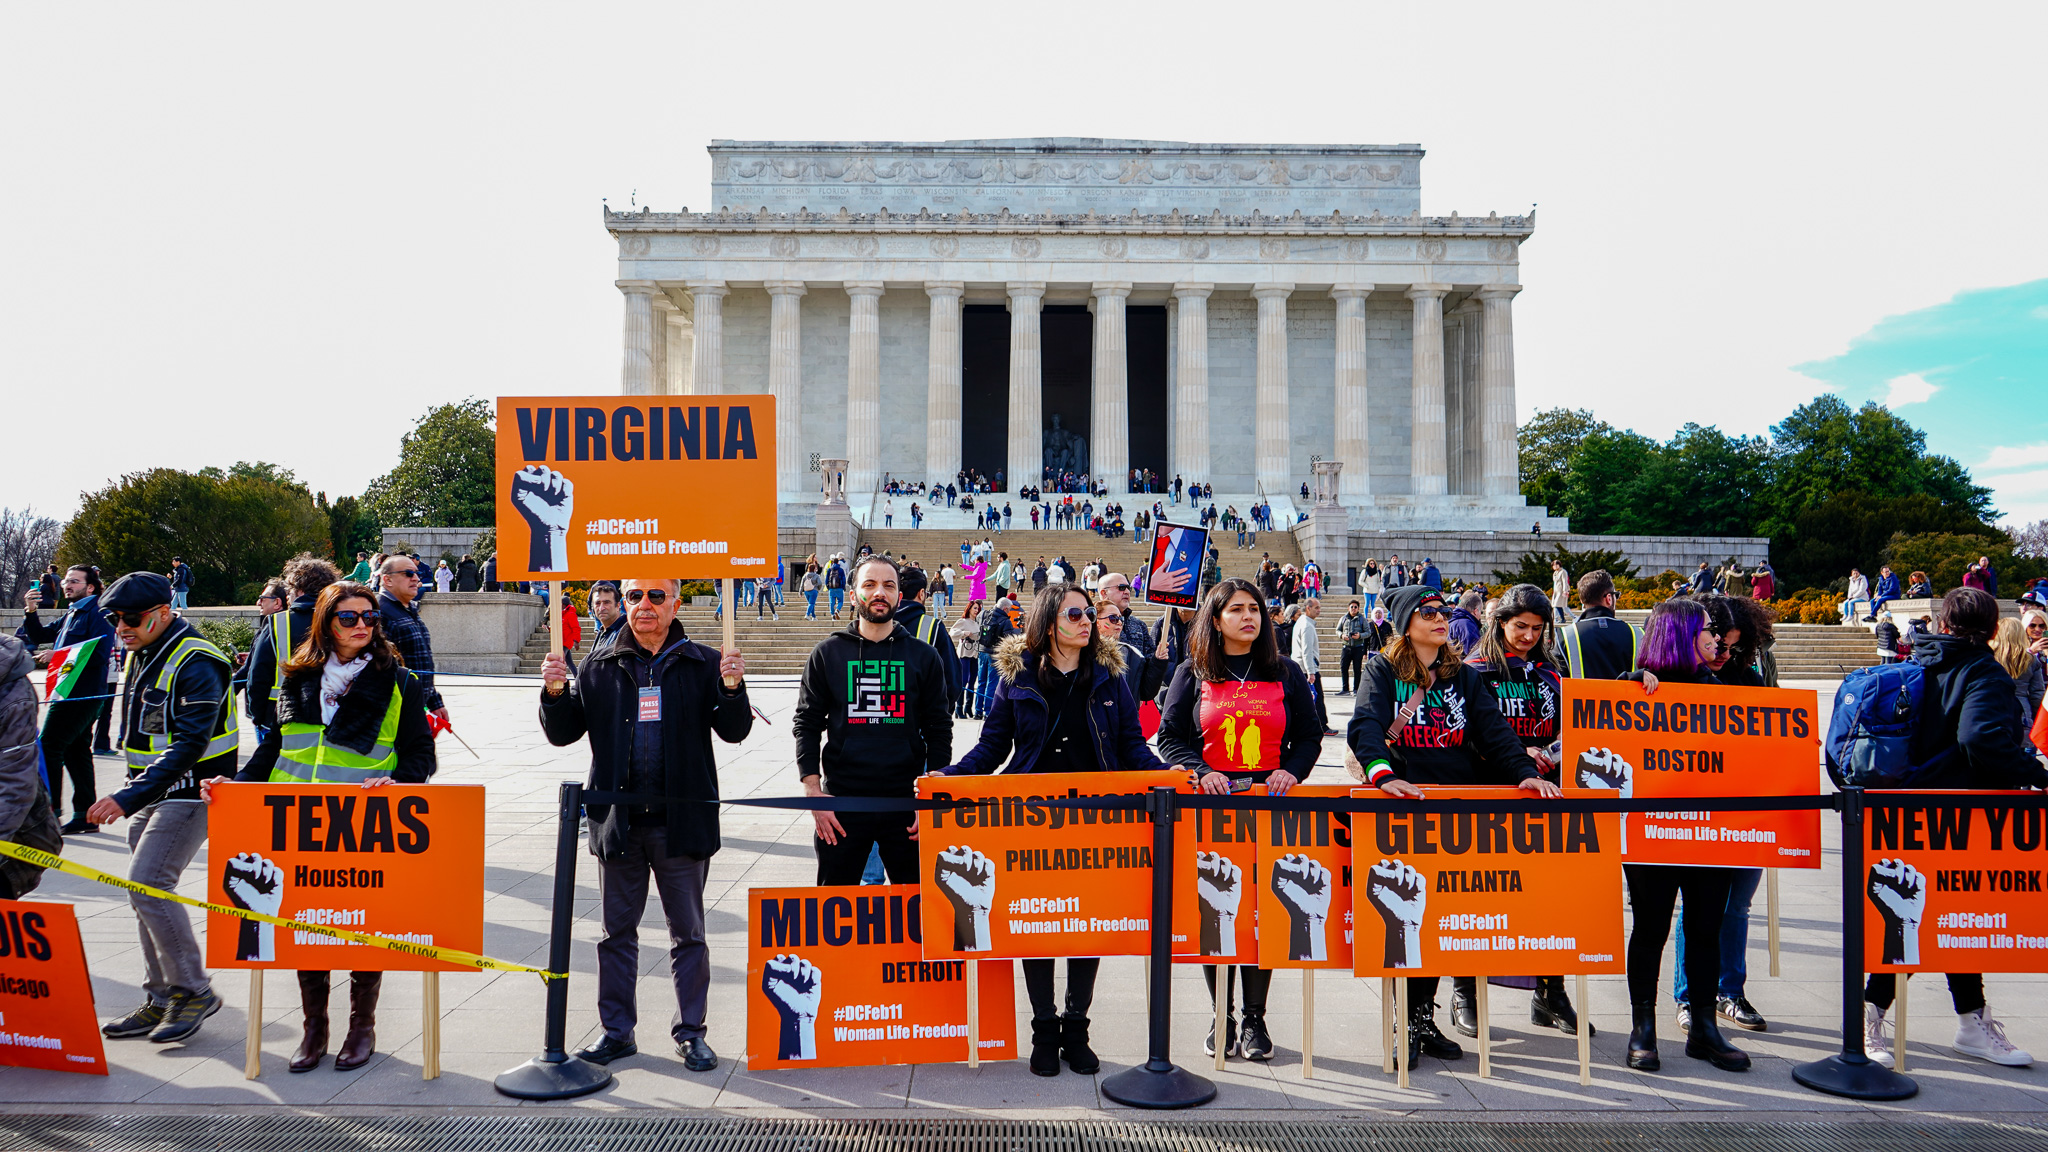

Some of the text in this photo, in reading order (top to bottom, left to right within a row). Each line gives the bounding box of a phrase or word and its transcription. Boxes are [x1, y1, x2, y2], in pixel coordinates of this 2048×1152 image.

[773, 187, 811, 195] MICHIGAN
[818, 187, 850, 195] FLORIDA
[860, 187, 883, 195] TEXAS
[975, 188, 1020, 196] CALIFORNIA
[1028, 188, 1073, 196] MINNESOTA
[1119, 189, 1148, 197] KANSAS
[1176, 189, 1211, 197] VIRGINIA
[1218, 189, 1247, 197] NEVADA
[1254, 189, 1291, 197] NEBRASKA
[515, 406, 758, 462] VIRGINIA
[586, 518, 659, 535] #DCFeb11
[586, 539, 728, 555] Woman Life Freedom
[640, 700, 659, 708] PRESS
[1572, 698, 1809, 738] MASSACHUSETTS
[1643, 748, 1724, 774] BOSTON
[264, 795, 430, 855] TEXAS
[1375, 798, 1600, 855] GEORGIA
[1871, 807, 2048, 851] NEW YO
[1644, 824, 1776, 844] Woman Life Freedom
[1006, 846, 1153, 872] PHILADELPHIA
[294, 865, 384, 888] Houston
[1436, 870, 1523, 893] ATLANTA
[1936, 870, 2042, 893] NEW YORK
[1008, 897, 1080, 915] #DCFeb11
[294, 908, 366, 925] #DCFeb11
[1438, 913, 1508, 930] #DCFeb11
[1937, 912, 2007, 928] #DCFeb11
[1008, 917, 1149, 934] Woman Life Freedom
[1438, 935, 1576, 951] Woman Life Freedom
[1937, 934, 1988, 949] Woman
[1990, 934, 2014, 949] Life
[882, 961, 965, 984] DETROIT
[833, 1003, 903, 1022] #DCFeb11
[833, 1023, 968, 1042] Woman Life Freedom
[13, 1033, 62, 1050] Freedom
